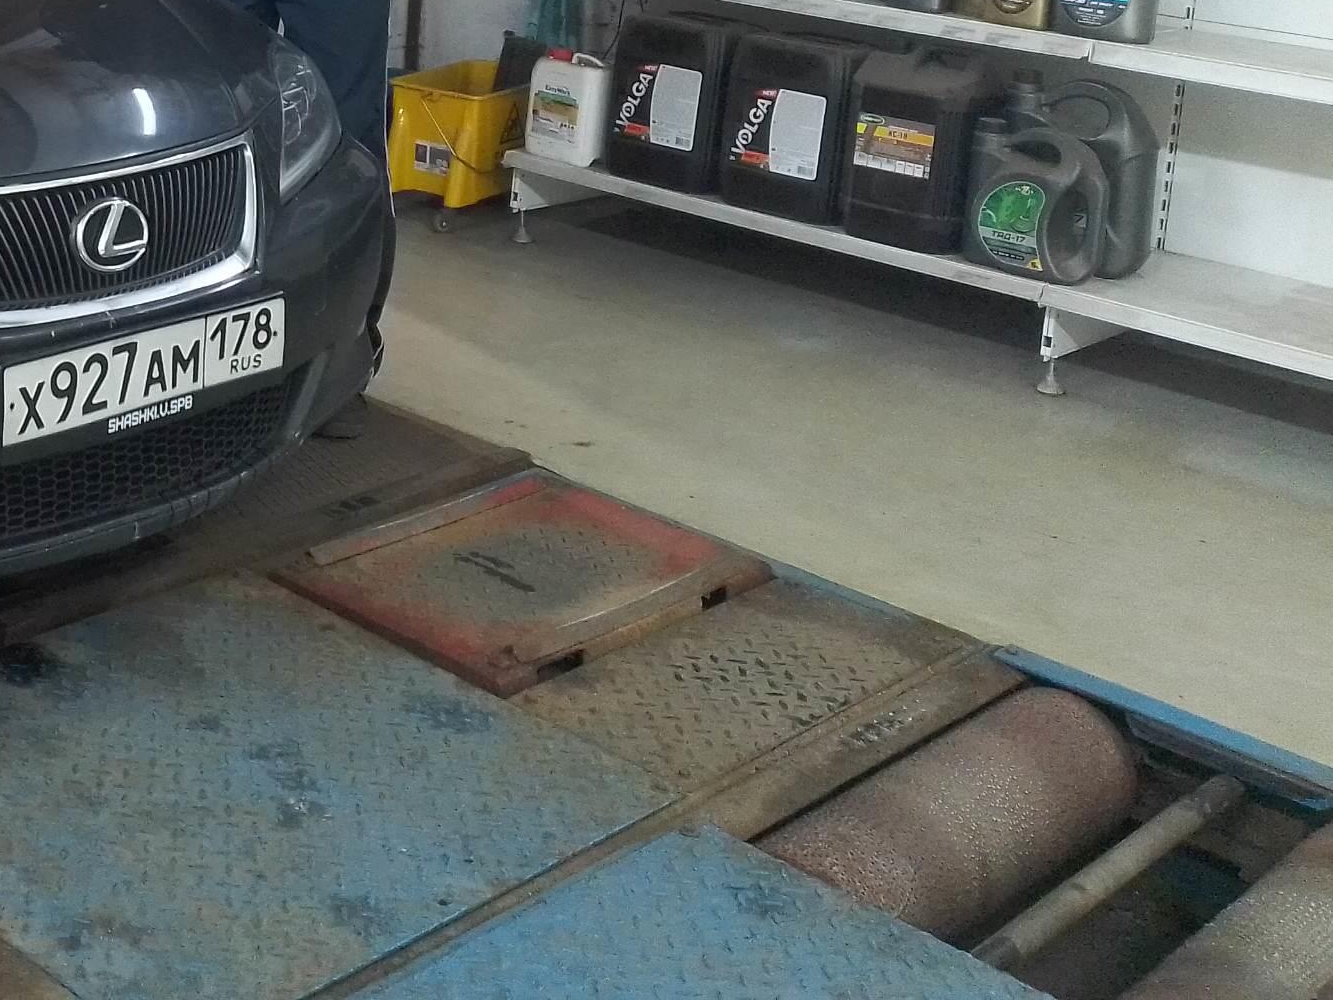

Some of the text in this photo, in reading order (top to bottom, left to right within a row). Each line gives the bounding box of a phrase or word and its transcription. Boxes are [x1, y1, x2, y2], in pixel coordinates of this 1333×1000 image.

[616, 73, 653, 126] VOLGA
[731, 98, 773, 153] VOLGA
[210, 308, 273, 361] 178
[229, 353, 263, 374] RUS
